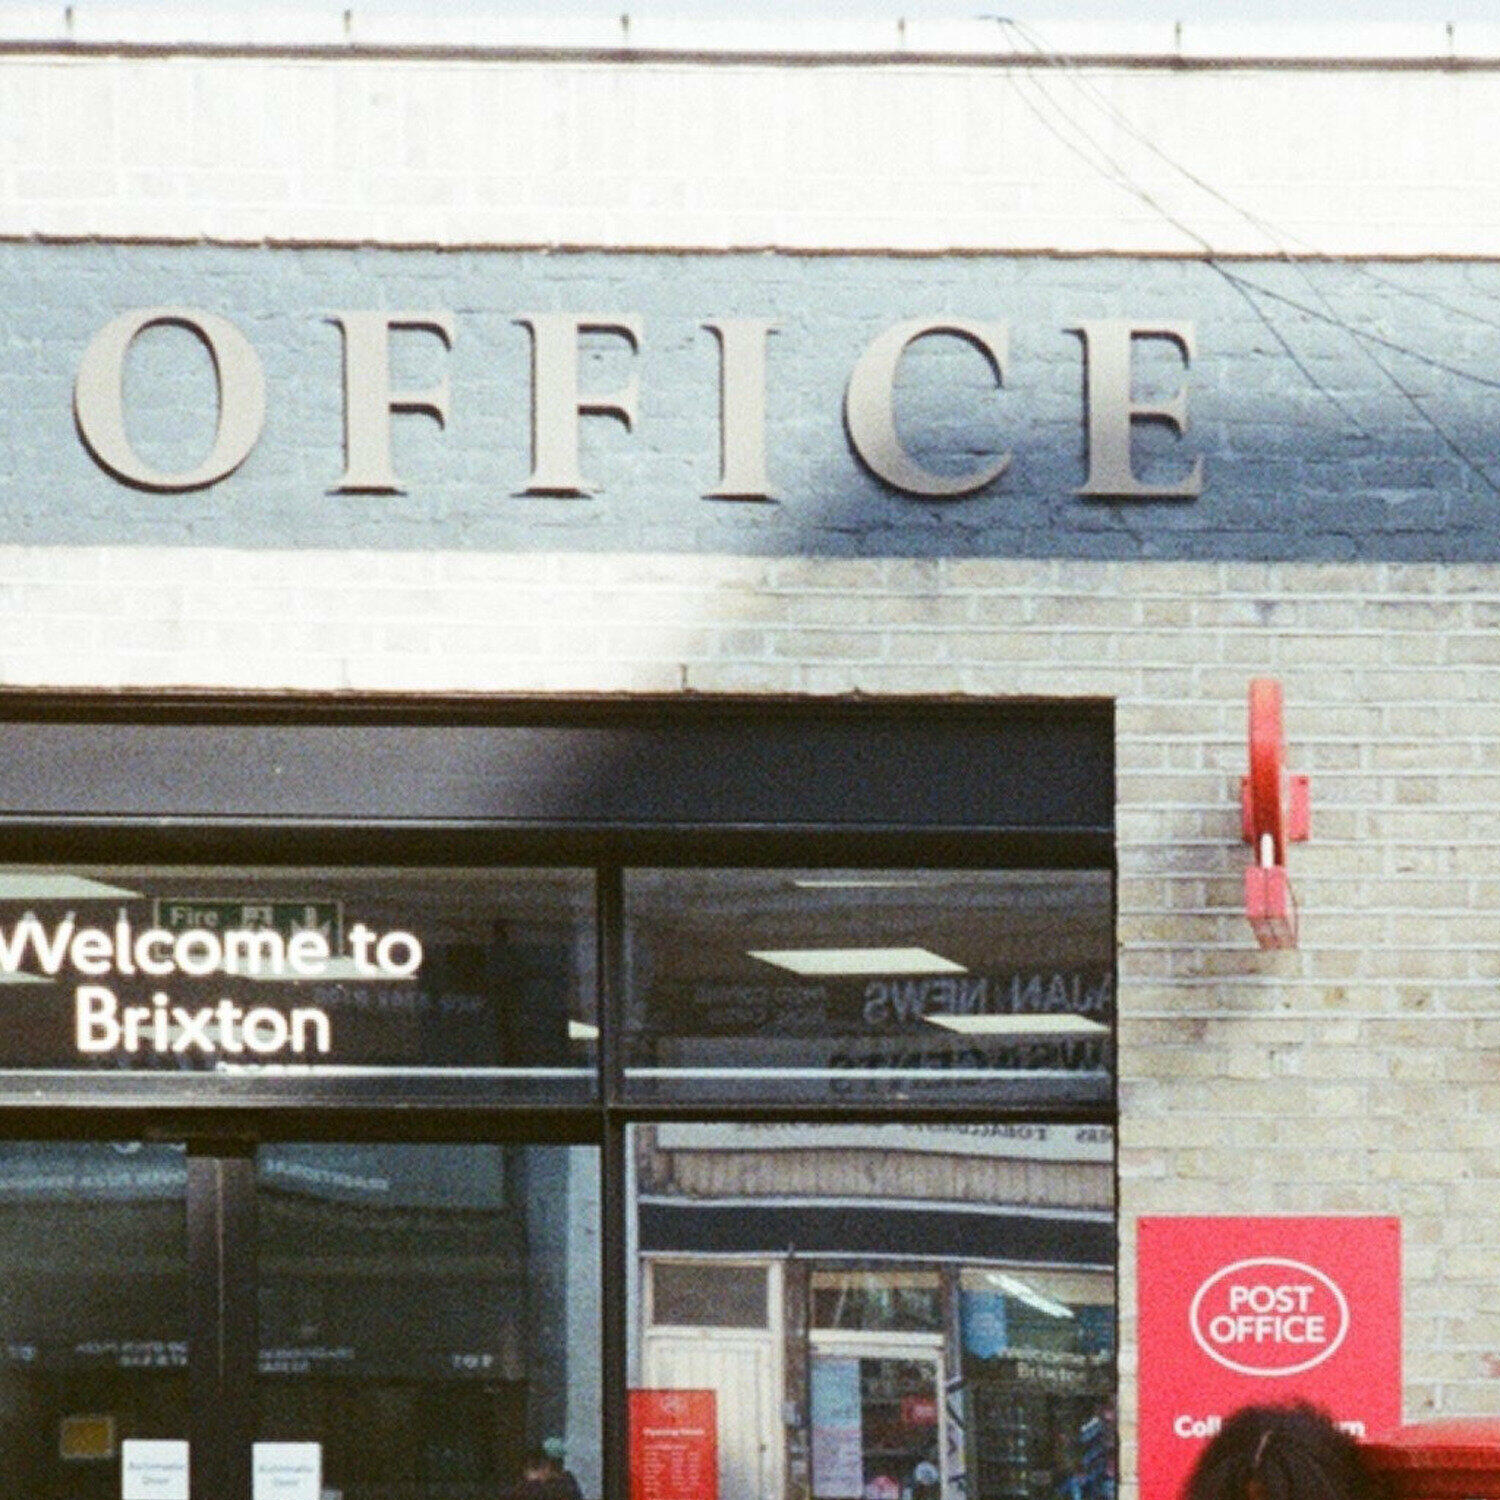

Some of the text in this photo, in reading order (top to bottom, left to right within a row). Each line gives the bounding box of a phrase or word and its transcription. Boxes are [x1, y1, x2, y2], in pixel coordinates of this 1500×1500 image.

[71, 306, 1205, 500] OFFICE
[0, 908, 422, 975] Welcome to
[76, 984, 330, 1053] Brixton
[1208, 1315, 1326, 1343] OFFICE
[1229, 1285, 1314, 1313] POST
